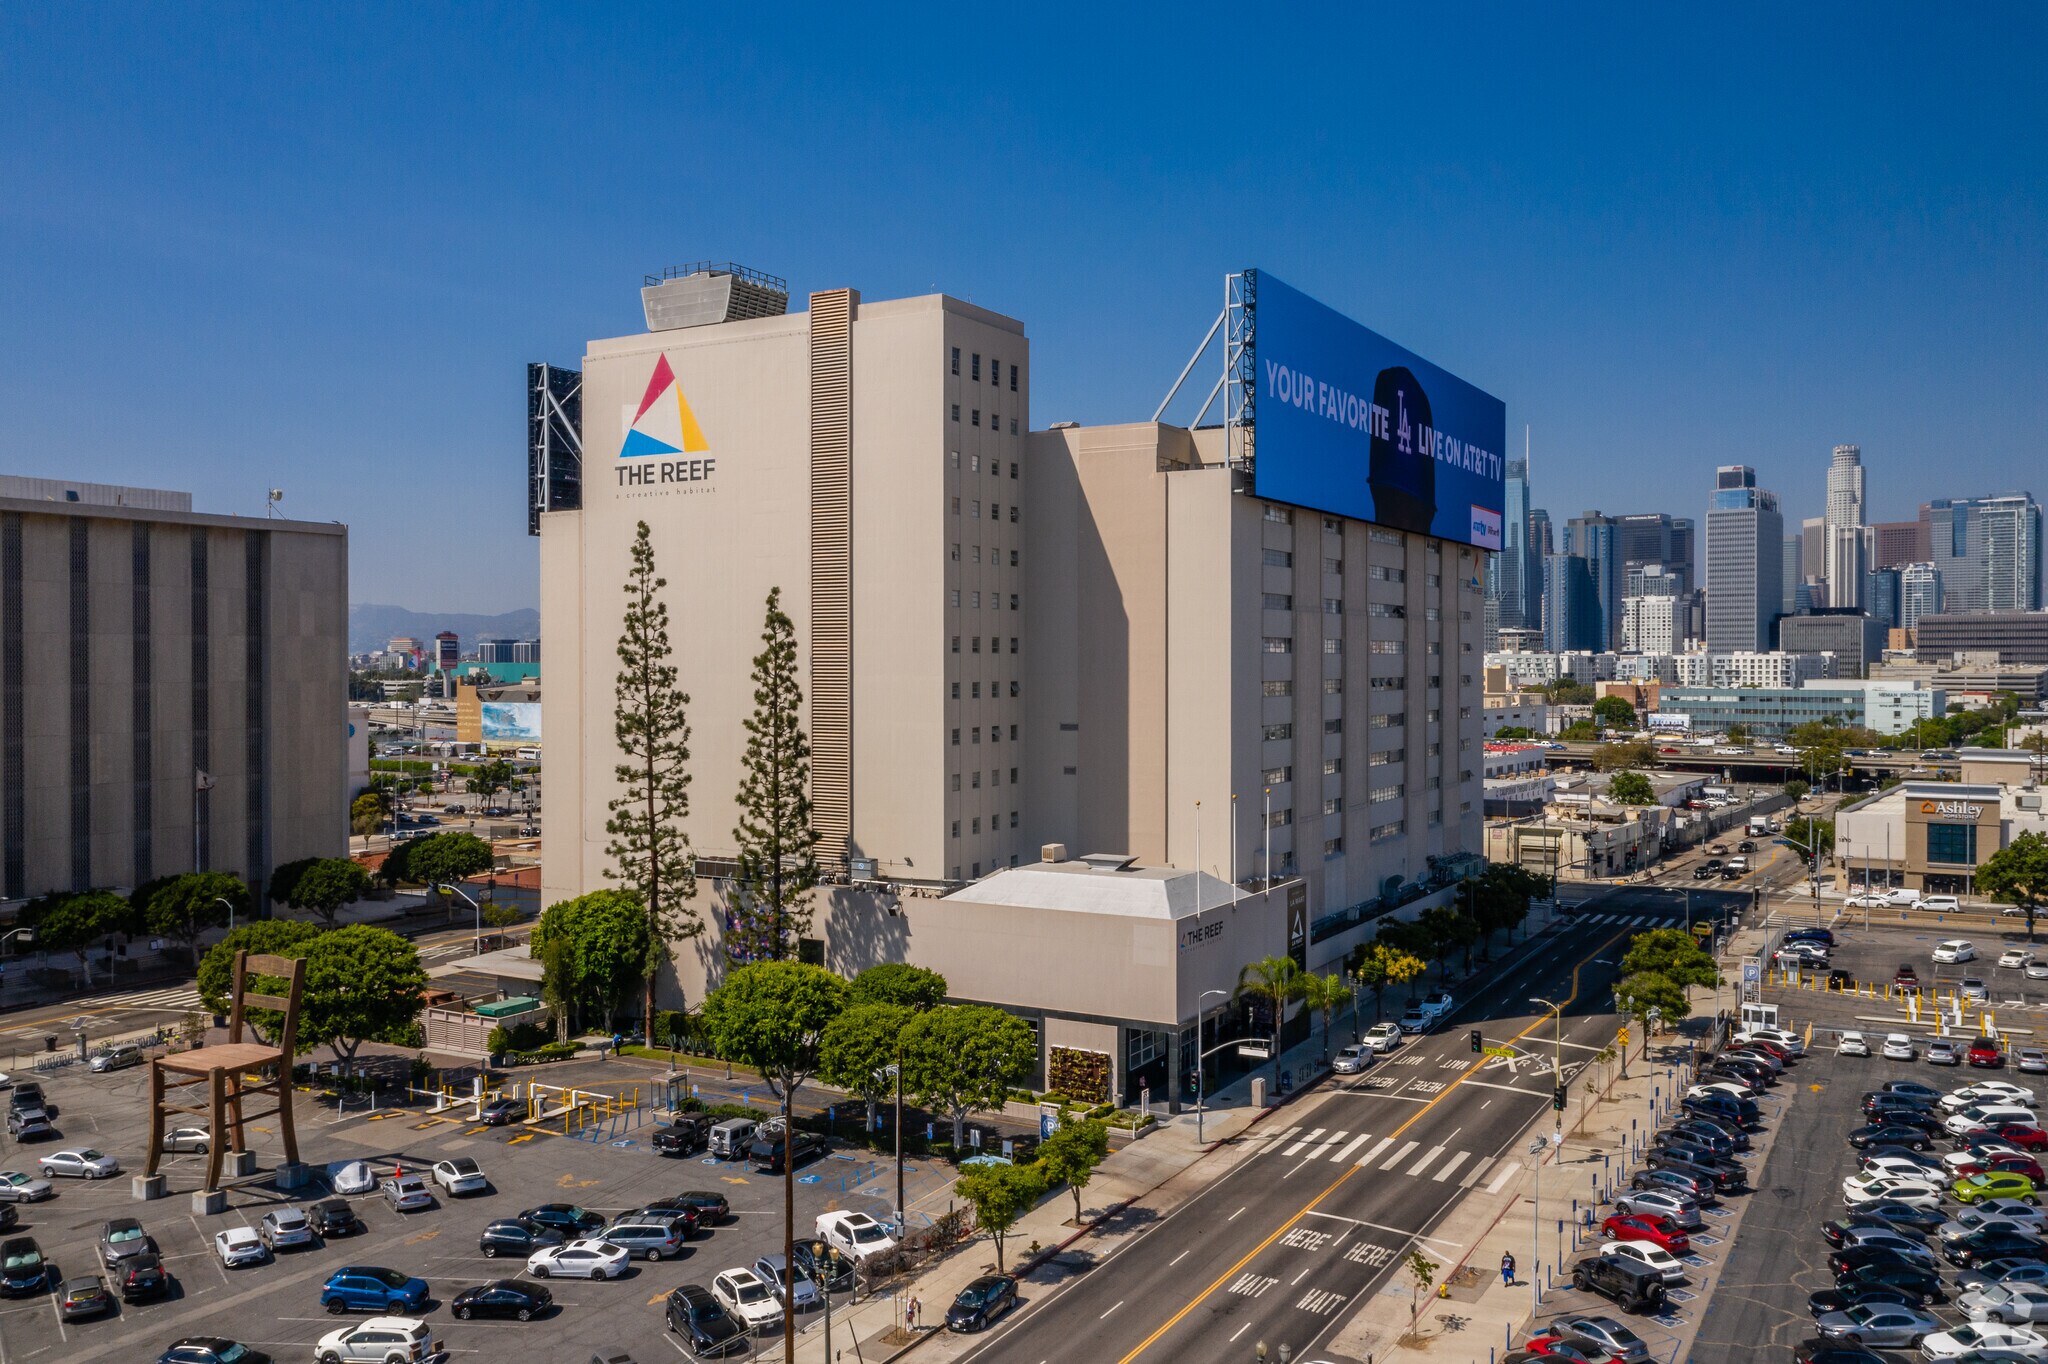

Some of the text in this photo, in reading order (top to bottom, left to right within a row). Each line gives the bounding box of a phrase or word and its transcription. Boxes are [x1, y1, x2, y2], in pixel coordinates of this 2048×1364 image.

[1265, 358, 1314, 413] YOUR
[1319, 381, 1390, 441] FAVORITE
[1418, 423, 1443, 462] LIVE
[1445, 435, 1460, 467] ON
[1463, 443, 1488, 476] AT&T
[1489, 454, 1501, 482] TV
[615, 458, 716, 486] THE REEF
[626, 489, 669, 499] creative
[677, 486, 716, 495] habitat
[1936, 801, 1984, 819] Ashley
[1187, 920, 1224, 946] THE REEF
[1394, 1055, 1426, 1066] WAIT
[1439, 1059, 1471, 1071] WAIT
[1408, 1080, 1447, 1093] HERE
[1279, 1227, 1333, 1252] HERE
[1343, 1242, 1397, 1268] HERE
[1228, 1272, 1280, 1298] WAIT
[1296, 1288, 1347, 1316] WAIT
